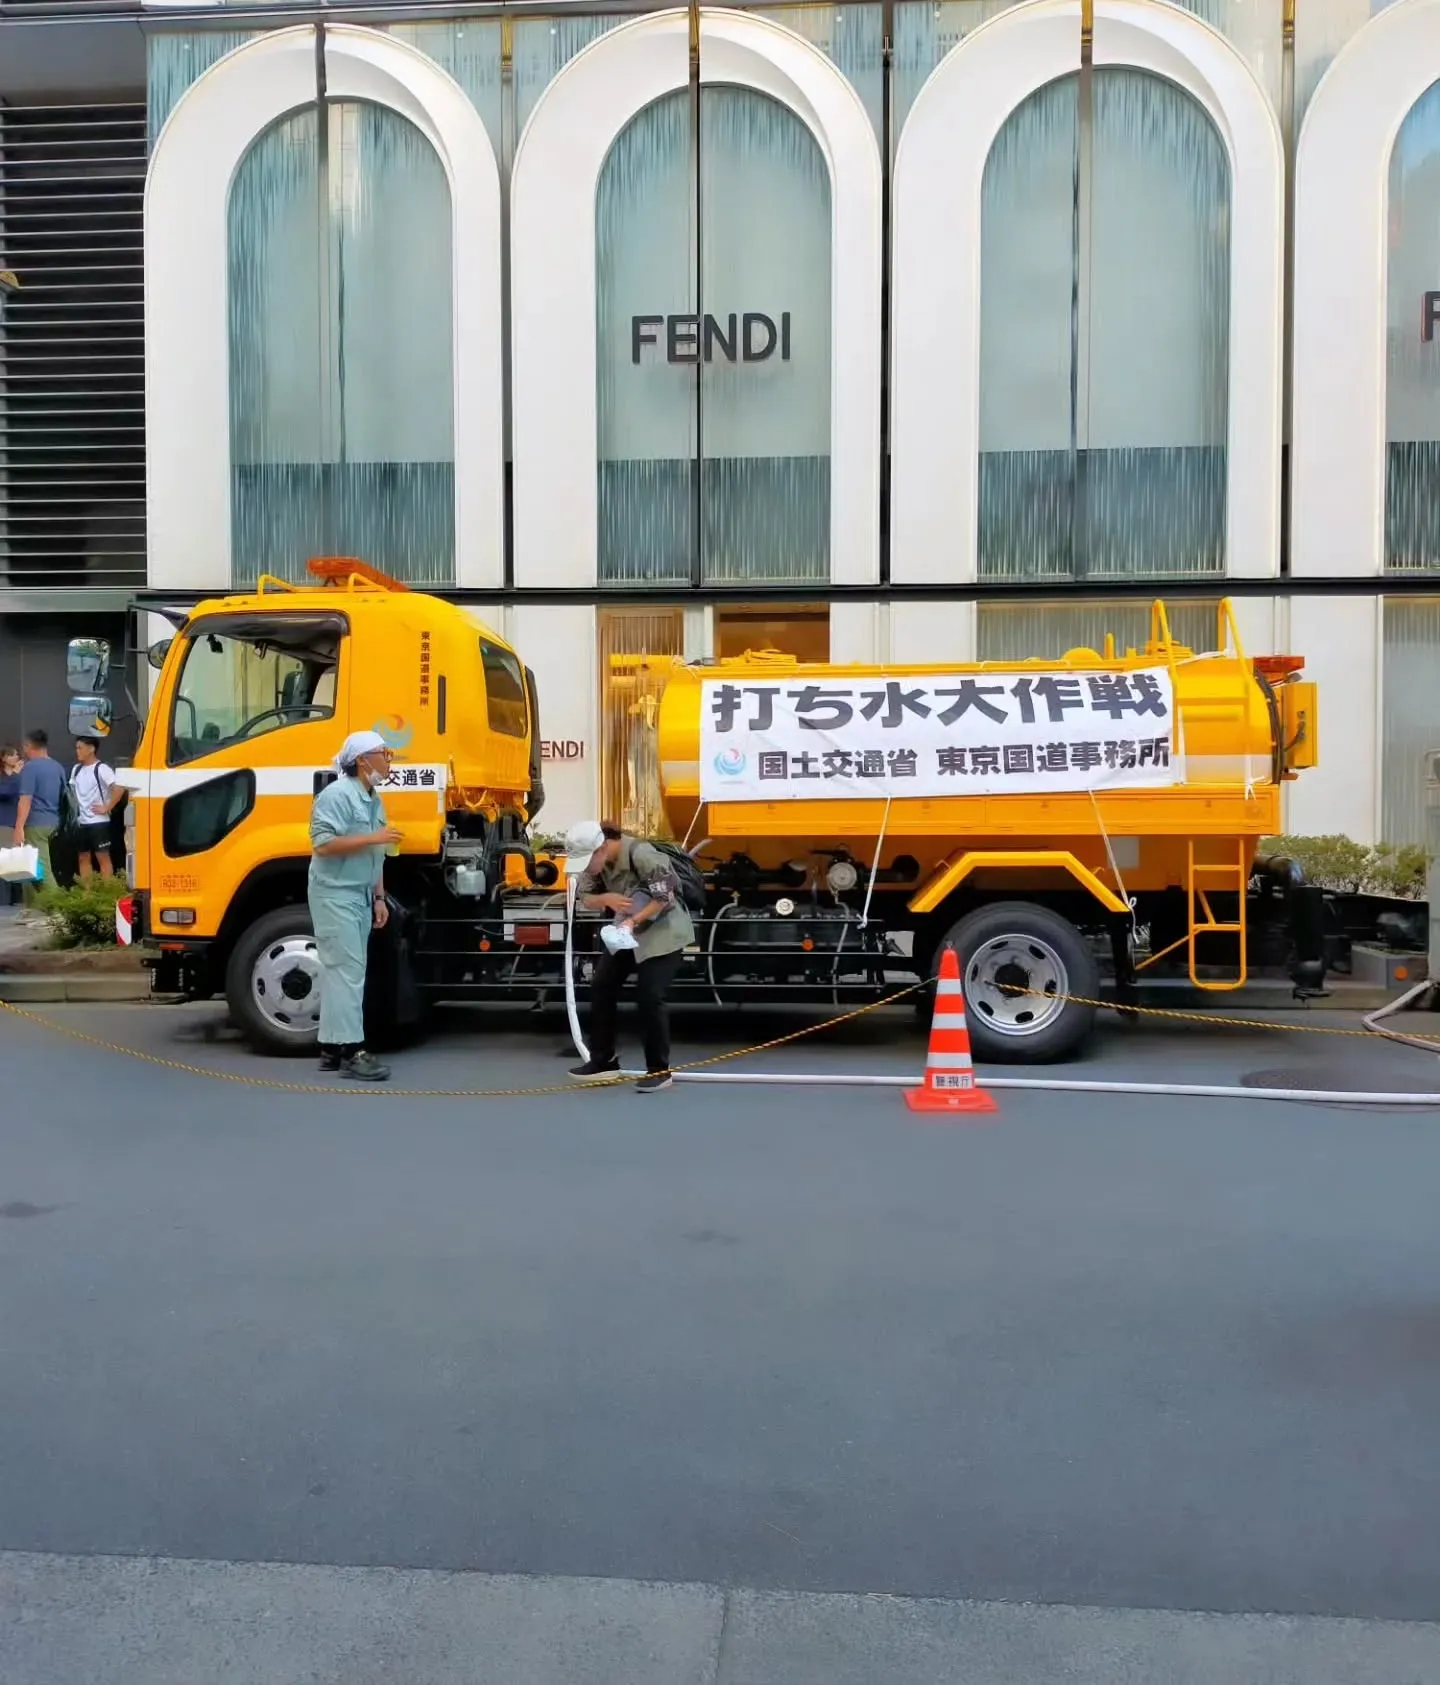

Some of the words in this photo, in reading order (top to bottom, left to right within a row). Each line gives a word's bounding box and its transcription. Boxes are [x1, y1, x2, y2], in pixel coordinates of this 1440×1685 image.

[632, 312, 790, 364] FENDI
[712, 674, 1168, 732] 打ち水大作戦
[540, 741, 584, 758] ENDI
[758, 748, 918, 780] 国土交通省
[936, 737, 1169, 776] 東京国道事務所
[376, 769, 436, 786] 交通省
